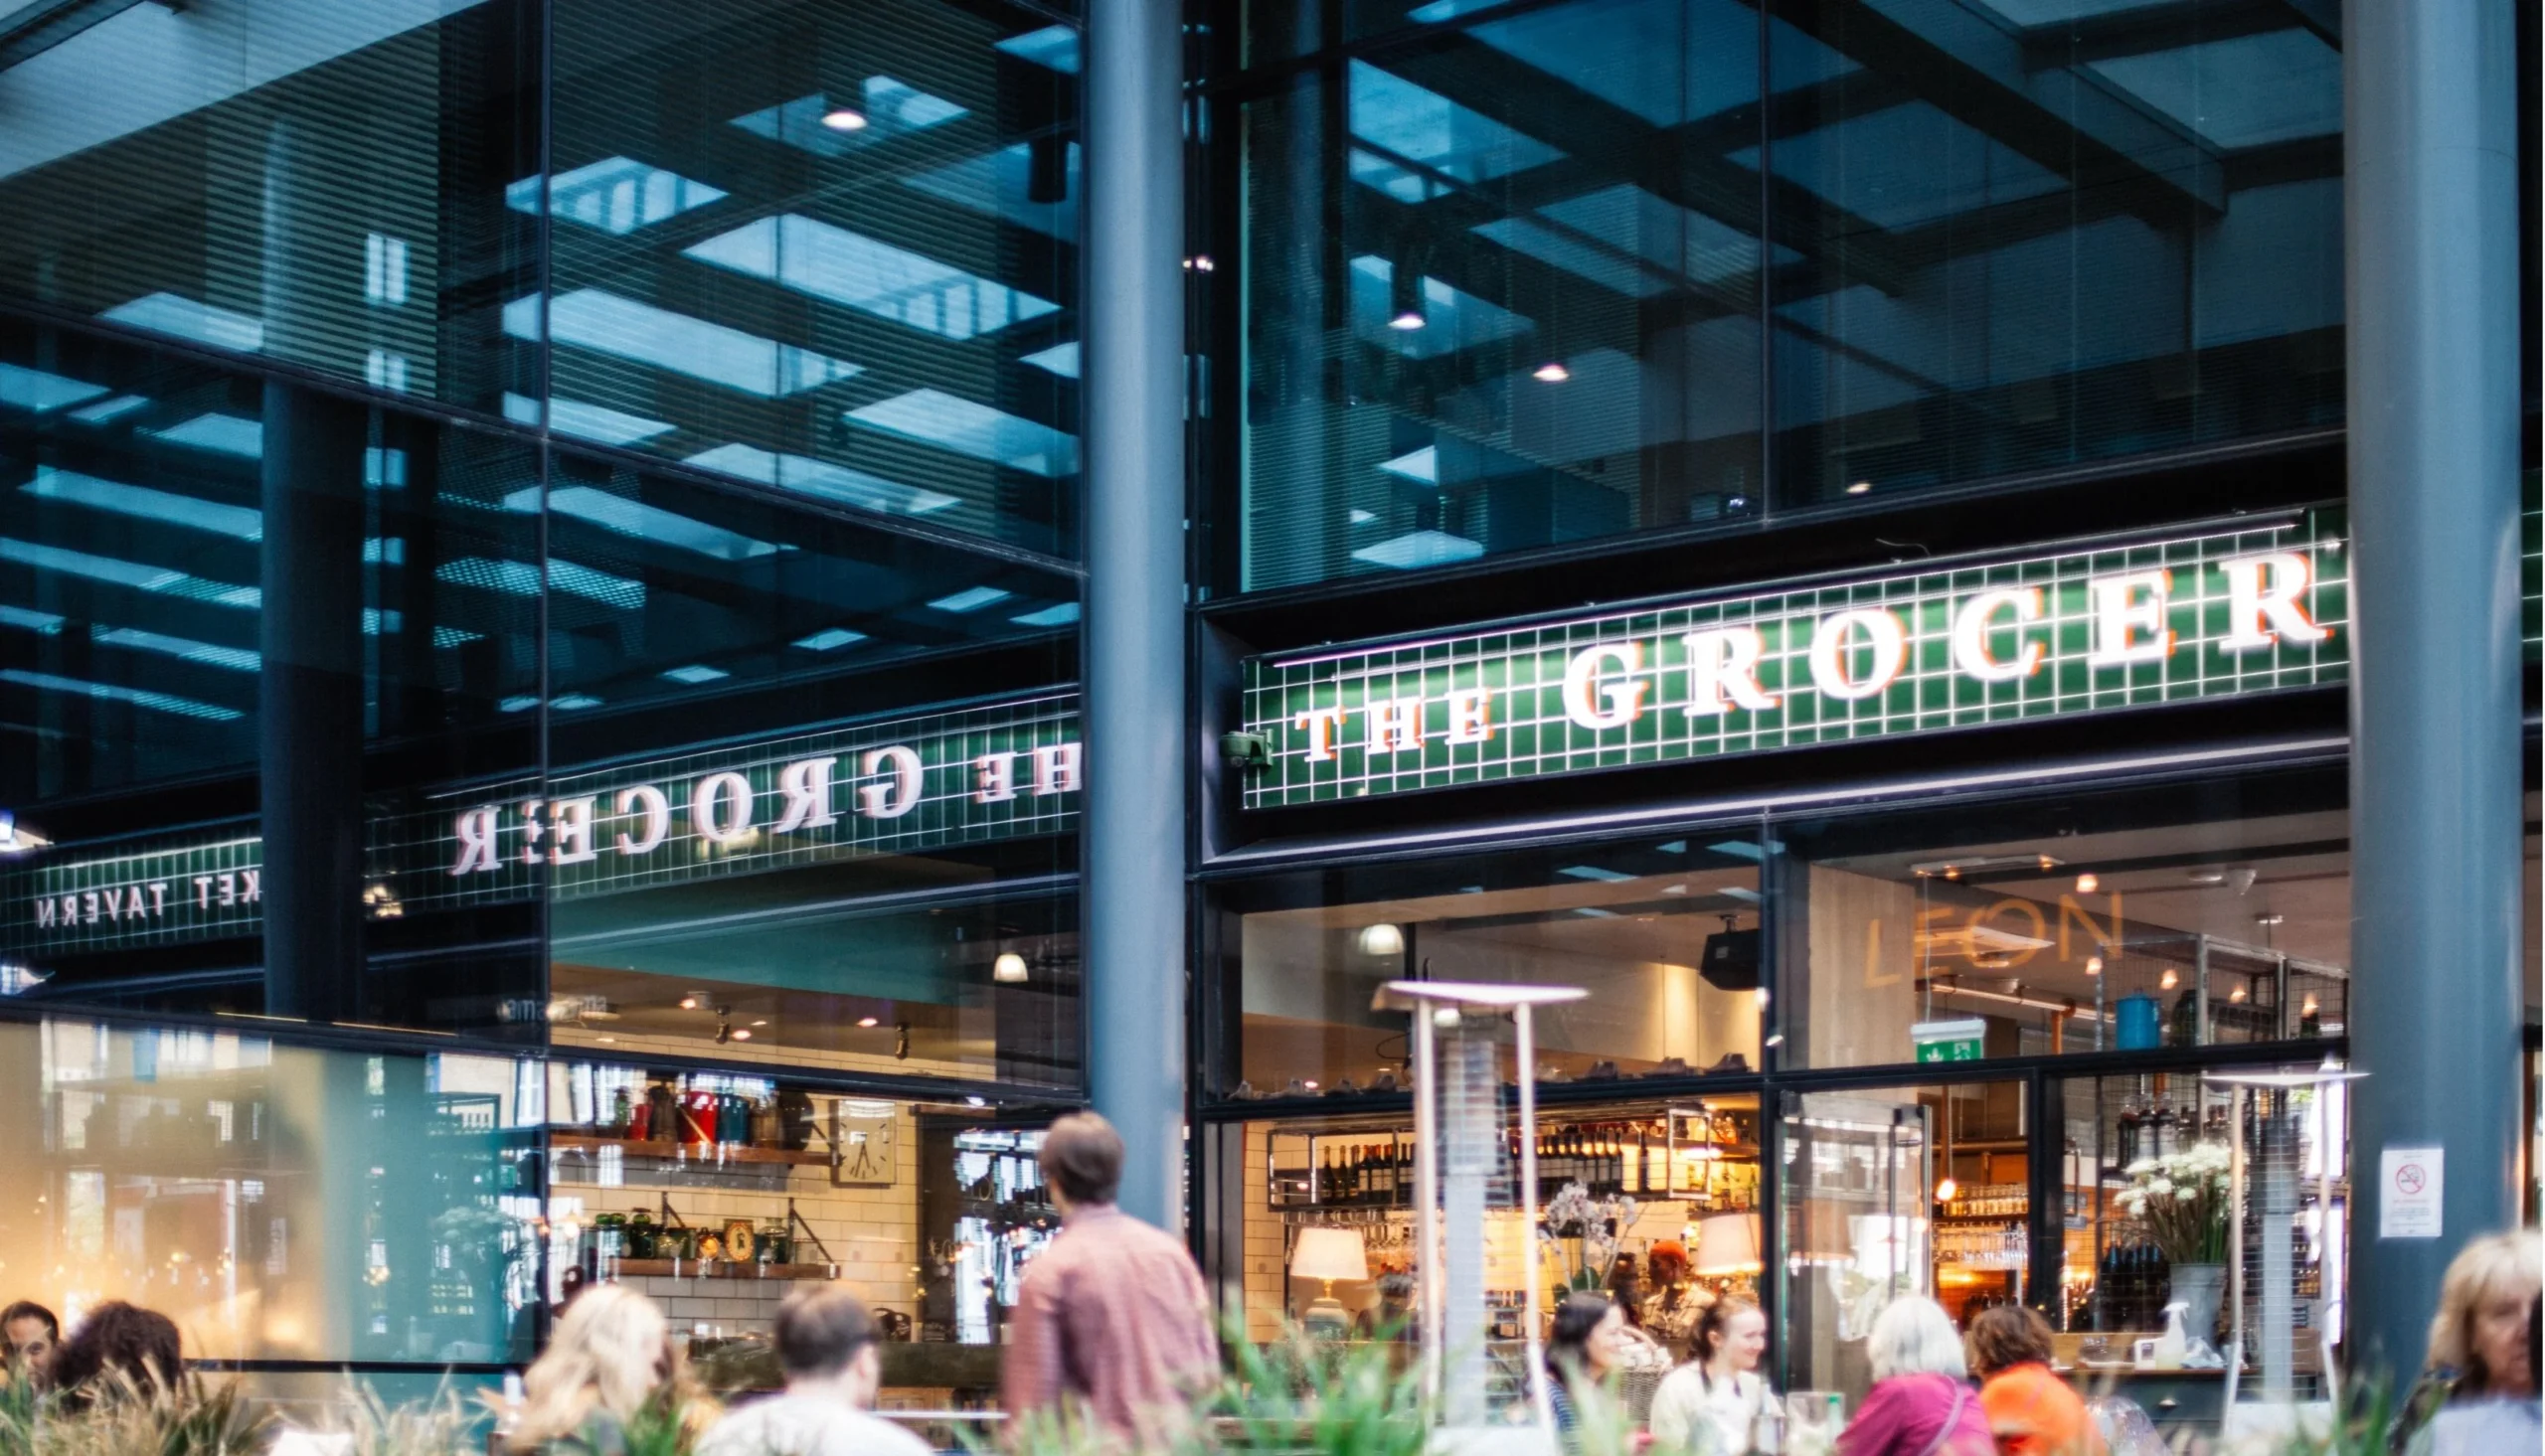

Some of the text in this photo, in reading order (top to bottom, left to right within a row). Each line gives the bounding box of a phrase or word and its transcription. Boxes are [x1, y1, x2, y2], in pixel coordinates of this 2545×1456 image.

[1294, 552, 2334, 762] THE GROCER
[1865, 890, 2123, 987] LEON
